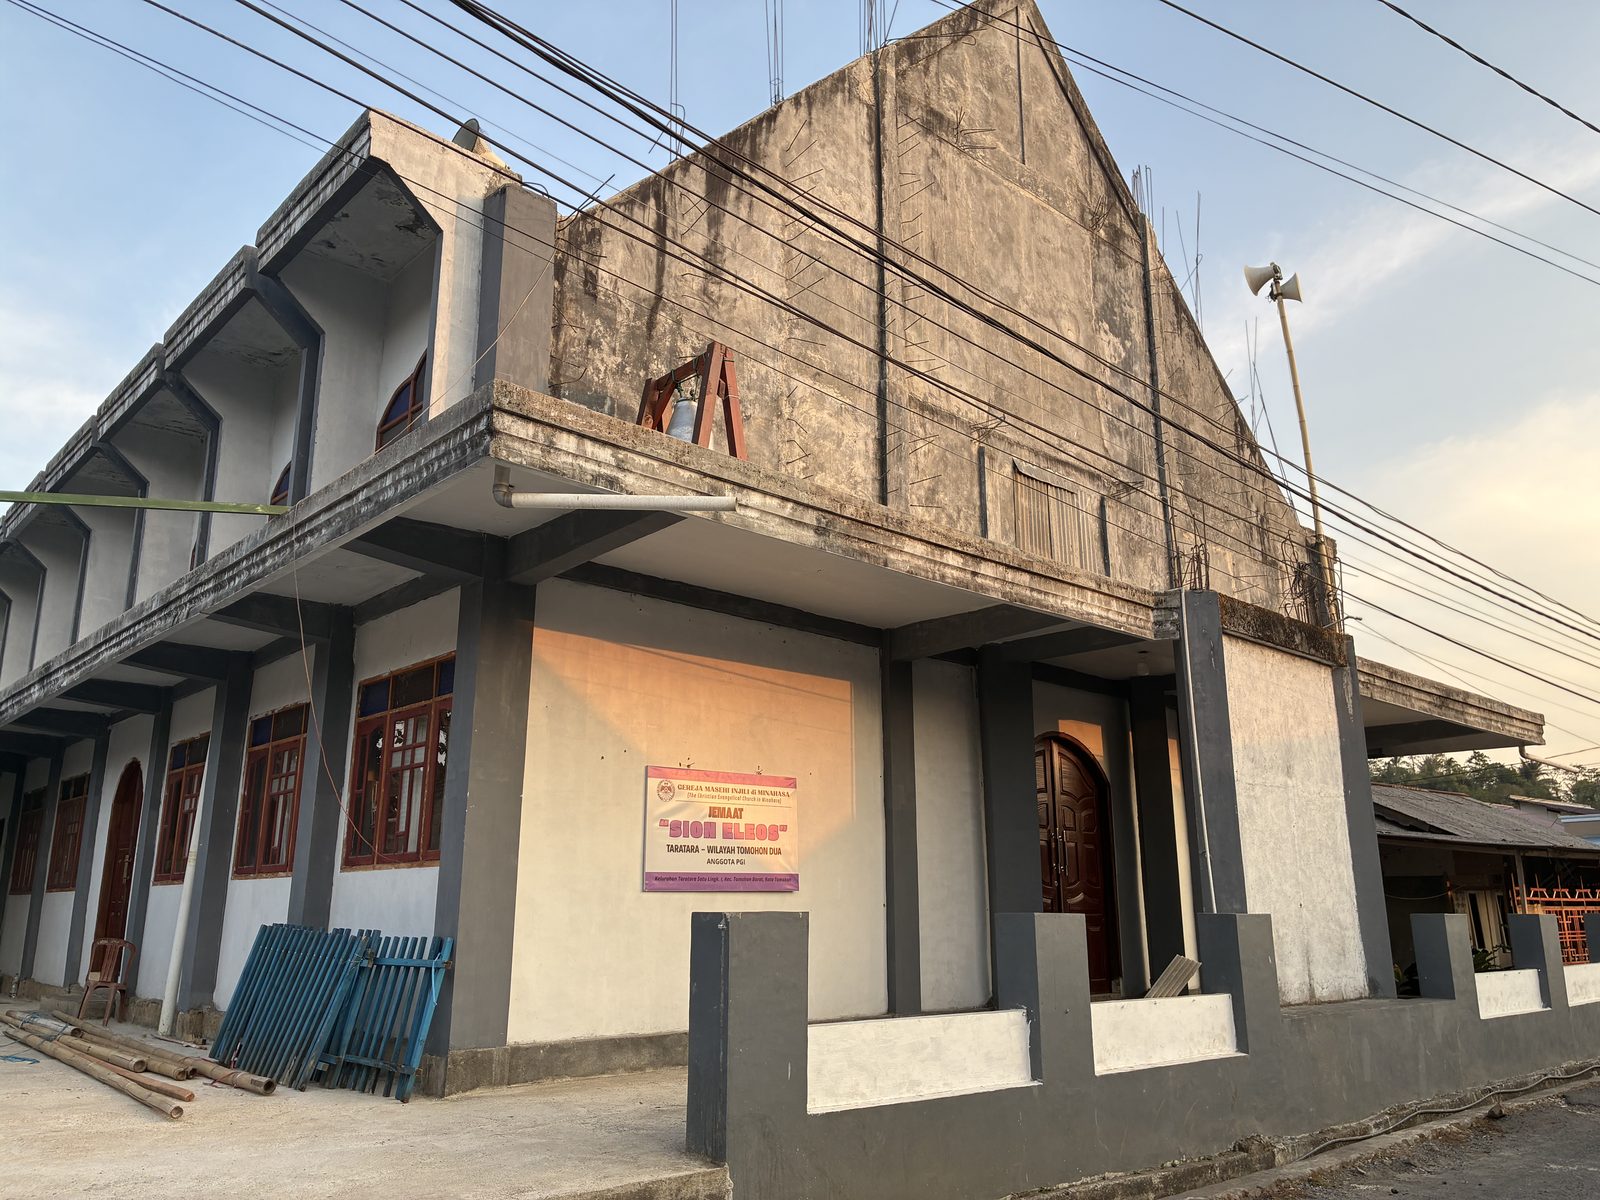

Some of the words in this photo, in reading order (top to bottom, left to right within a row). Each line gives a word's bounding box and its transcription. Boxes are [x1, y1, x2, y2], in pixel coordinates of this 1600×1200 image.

[677, 784, 703, 792] GEREJA
[704, 785, 730, 793] MASEHI
[731, 787, 750, 795] INJILI
[757, 789, 790, 797] MINAHASA
[708, 806, 744, 819] JEMAAT
[666, 844, 700, 853] TARATARA
[706, 845, 736, 854] WILAYAH
[736, 846, 769, 855] TOMOHON
[769, 847, 782, 856] DUA
